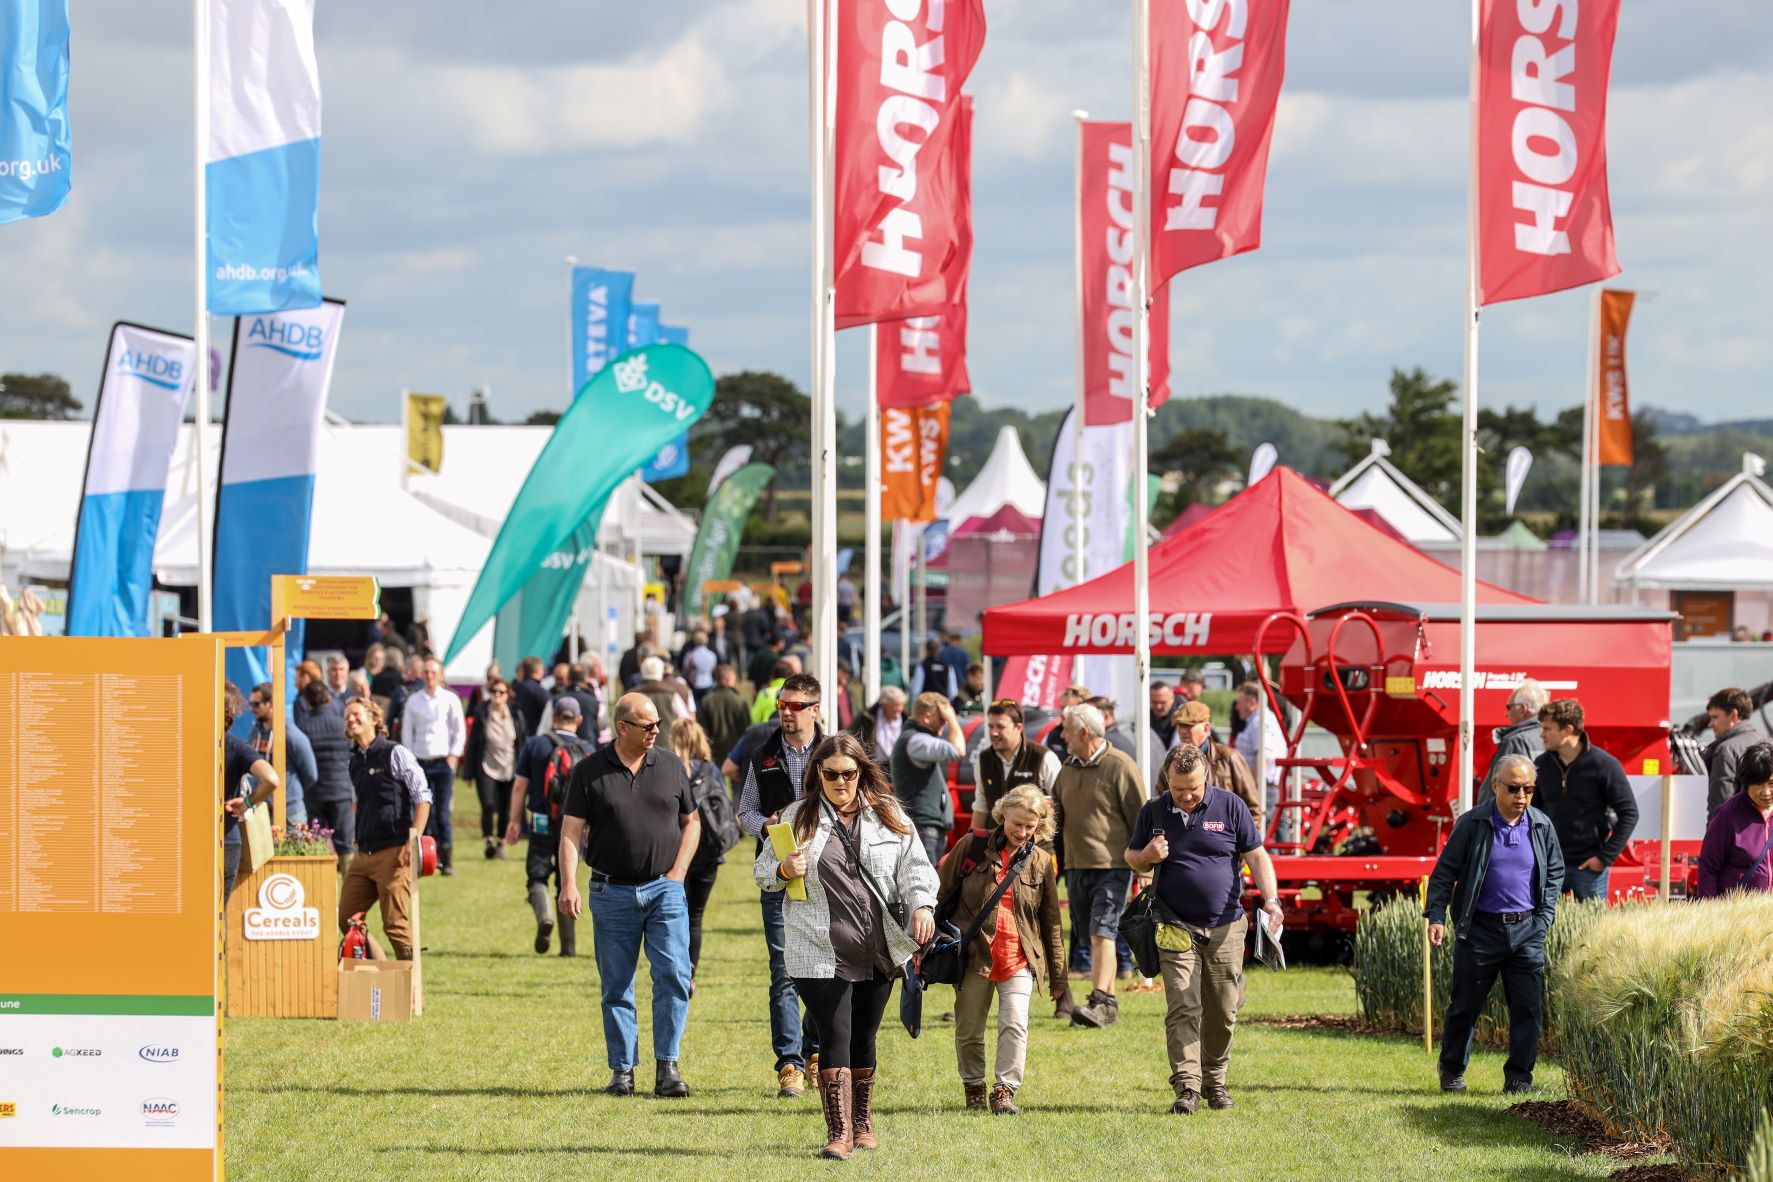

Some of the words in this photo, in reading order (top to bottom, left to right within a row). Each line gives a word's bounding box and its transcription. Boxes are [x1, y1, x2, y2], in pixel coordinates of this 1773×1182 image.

[248, 318, 322, 348] AHDB
[118, 347, 183, 380] AHDB
[644, 380, 696, 421] DSV
[1056, 461, 1094, 592] eeds
[1063, 612, 1213, 647] HORSCH
[1423, 670, 1487, 689] HORSH
[247, 911, 317, 928] Cereals
[64, 1049, 102, 1057] AGXEED
[145, 1048, 179, 1057] NIAB
[62, 1106, 102, 1116] Sencrop
[143, 1103, 177, 1114] NAAC
